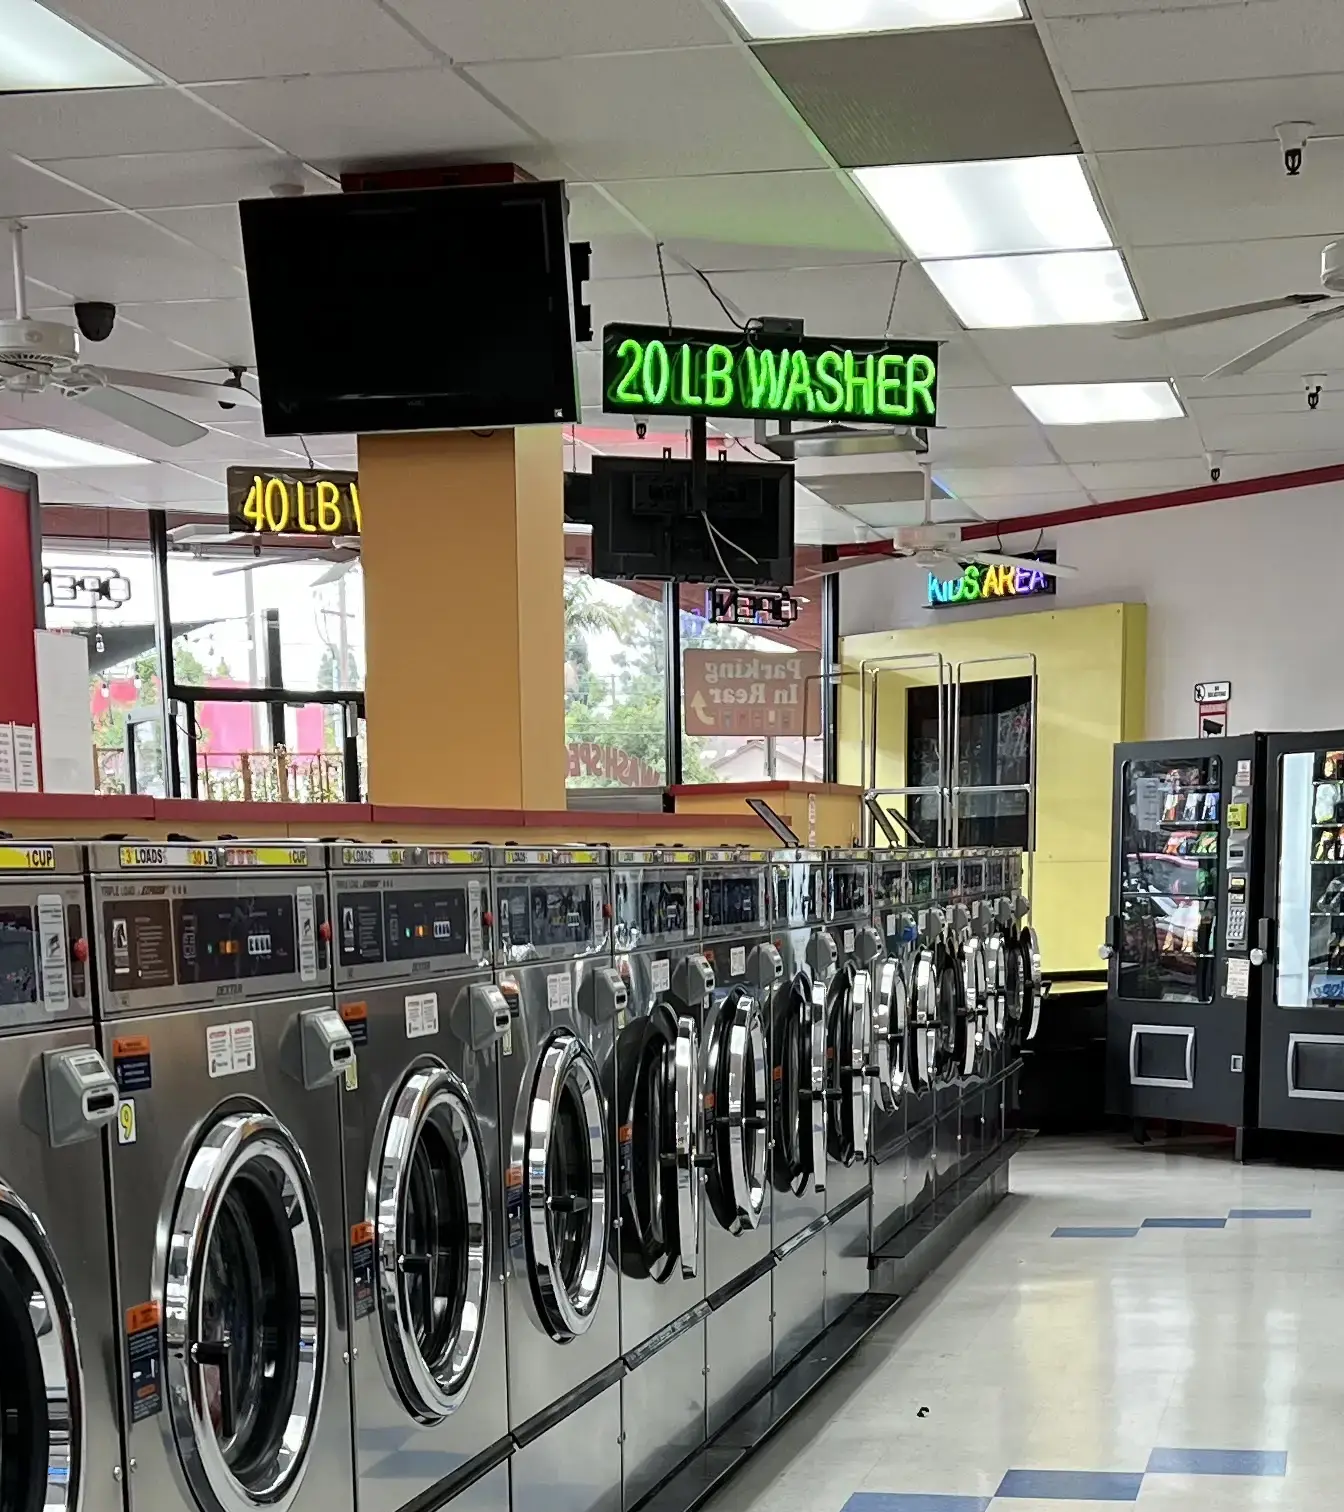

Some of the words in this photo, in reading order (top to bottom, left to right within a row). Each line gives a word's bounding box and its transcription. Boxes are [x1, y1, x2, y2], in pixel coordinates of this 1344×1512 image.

[617, 339, 670, 404] 20
[681, 344, 734, 406] LB
[746, 347, 936, 415] WASHER
[244, 475, 289, 533] 40
[297, 481, 342, 532] LB
[928, 566, 980, 604] KIDS
[981, 563, 1046, 598] AREA
[31, 850, 53, 867] CUP
[135, 848, 163, 865] LOADS
[119, 1103, 133, 1141] 9
